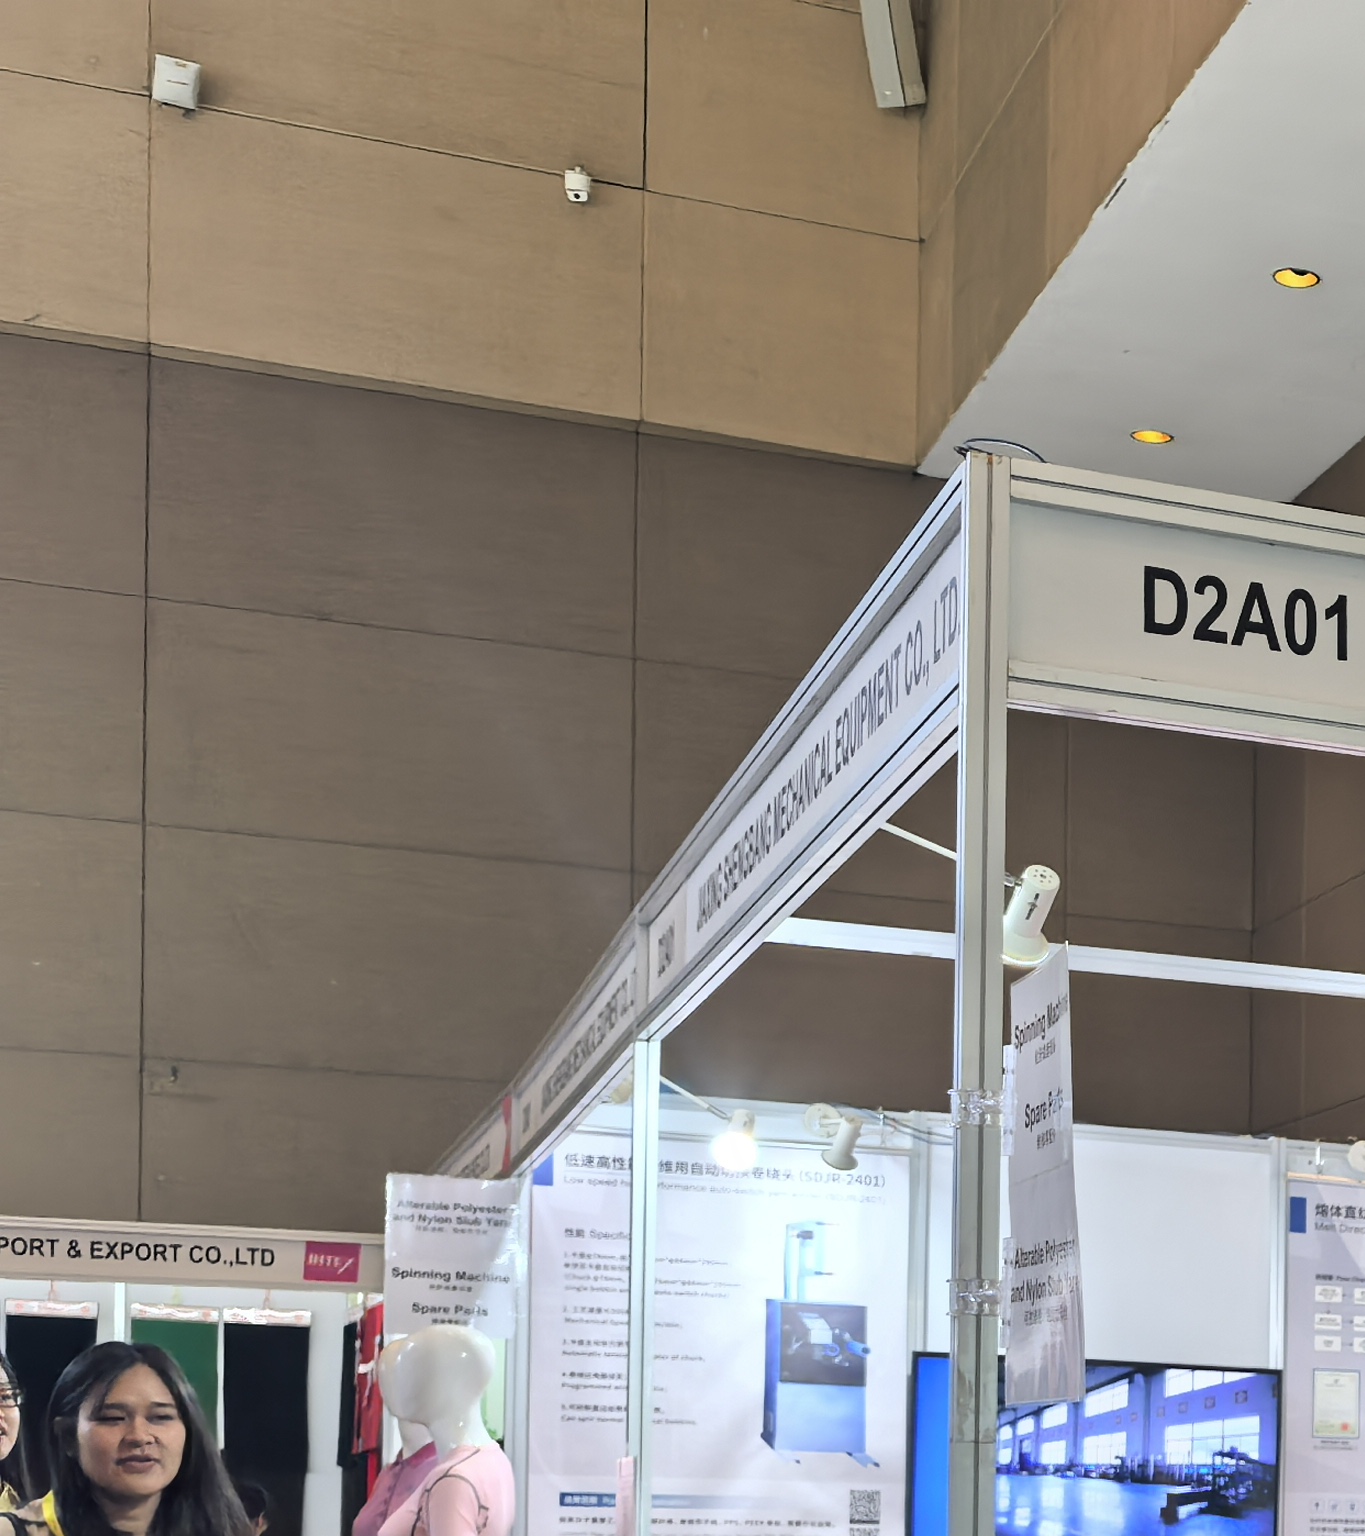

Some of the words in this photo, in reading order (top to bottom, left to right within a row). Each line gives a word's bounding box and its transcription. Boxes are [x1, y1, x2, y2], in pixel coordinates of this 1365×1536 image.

[1143, 566, 1348, 661] D2A01
[773, 729, 833, 847] MECHANICAL
[835, 643, 902, 775] EQUIPMENT
[905, 619, 930, 696] CO.,
[1014, 1013, 1046, 1054] Spinning
[1024, 1100, 1047, 1133] Spare
[417, 1214, 452, 1225] Nylon
[453, 1202, 508, 1215] Polyester
[66, 1238, 82, 1259] &
[89, 1239, 183, 1263] EXPORT
[189, 1244, 275, 1268] CO.,LTD
[1013, 1246, 1045, 1270] Alterable
[391, 1266, 452, 1282] Spinning
[1010, 1279, 1025, 1303] and
[1025, 1277, 1047, 1307] Nylon
[411, 1301, 451, 1315] Spare
